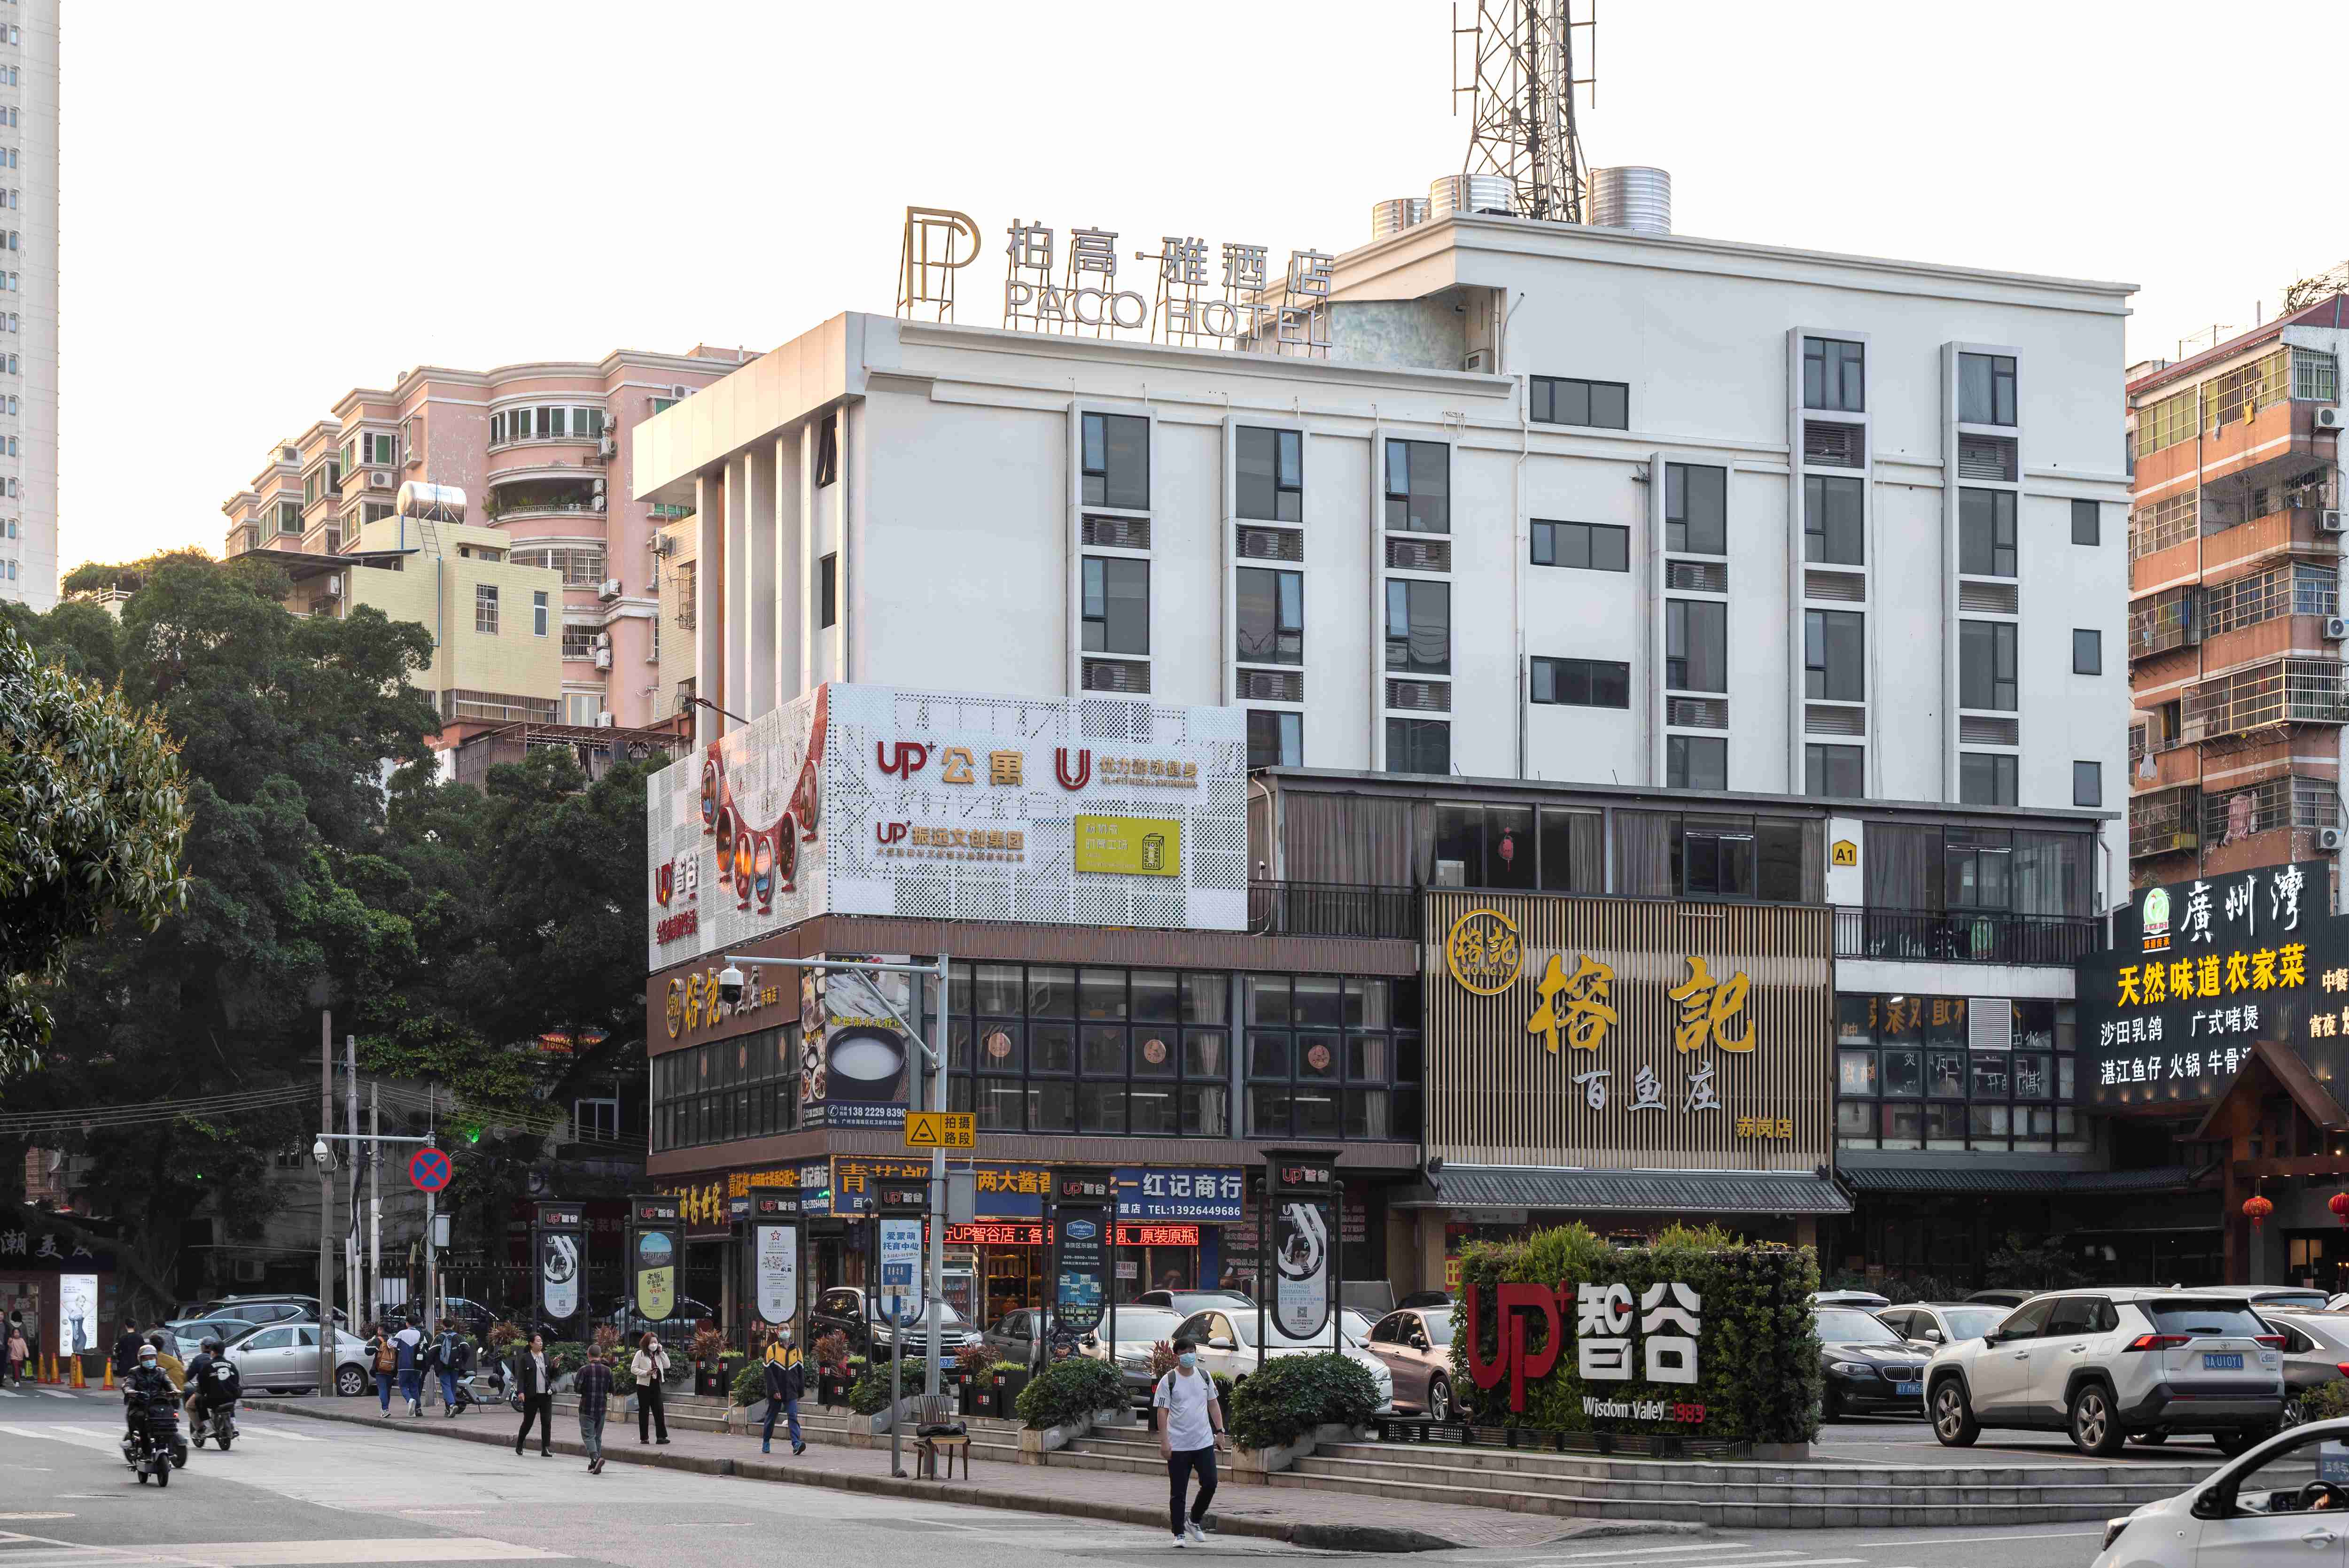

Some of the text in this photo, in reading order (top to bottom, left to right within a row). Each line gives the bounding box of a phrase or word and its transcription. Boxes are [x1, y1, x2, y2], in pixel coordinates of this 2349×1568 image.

[1005, 280, 1333, 348] PACO HOTEL
[942, 746, 1023, 786] 公寓
[1100, 755, 1198, 777] 优力游泳健身
[912, 826, 1024, 849] 振远文创集团
[1835, 851, 1853, 862] A1
[2180, 864, 2306, 943] 廣州灣
[1461, 966, 1512, 977] RONGJI
[2117, 943, 2307, 1007] 天然味道农家菜
[2100, 1004, 2259, 1046] 沙田乳鸽 广式啫煲
[2101, 1055, 2162, 1086] 湛江鱼仔
[2169, 1052, 2201, 1079] 火锅
[1571, 1062, 1721, 1114] 百鱼庄
[848, 1106, 863, 1116] 138
[865, 1107, 885, 1117] 2229
[887, 1108, 906, 1117] 8390
[944, 1116, 970, 1129] 拍摄
[944, 1132, 970, 1145] 路段
[1735, 1117, 1794, 1139] 赤岗店
[1142, 1172, 1243, 1199] 红记商行
[1148, 1204, 1241, 1216] TEL:13926449686
[883, 1242, 919, 1250] 托育中心
[1578, 1282, 1701, 1384] 智谷
[1583, 1396, 1706, 1423] Wisdom Valley 1983
